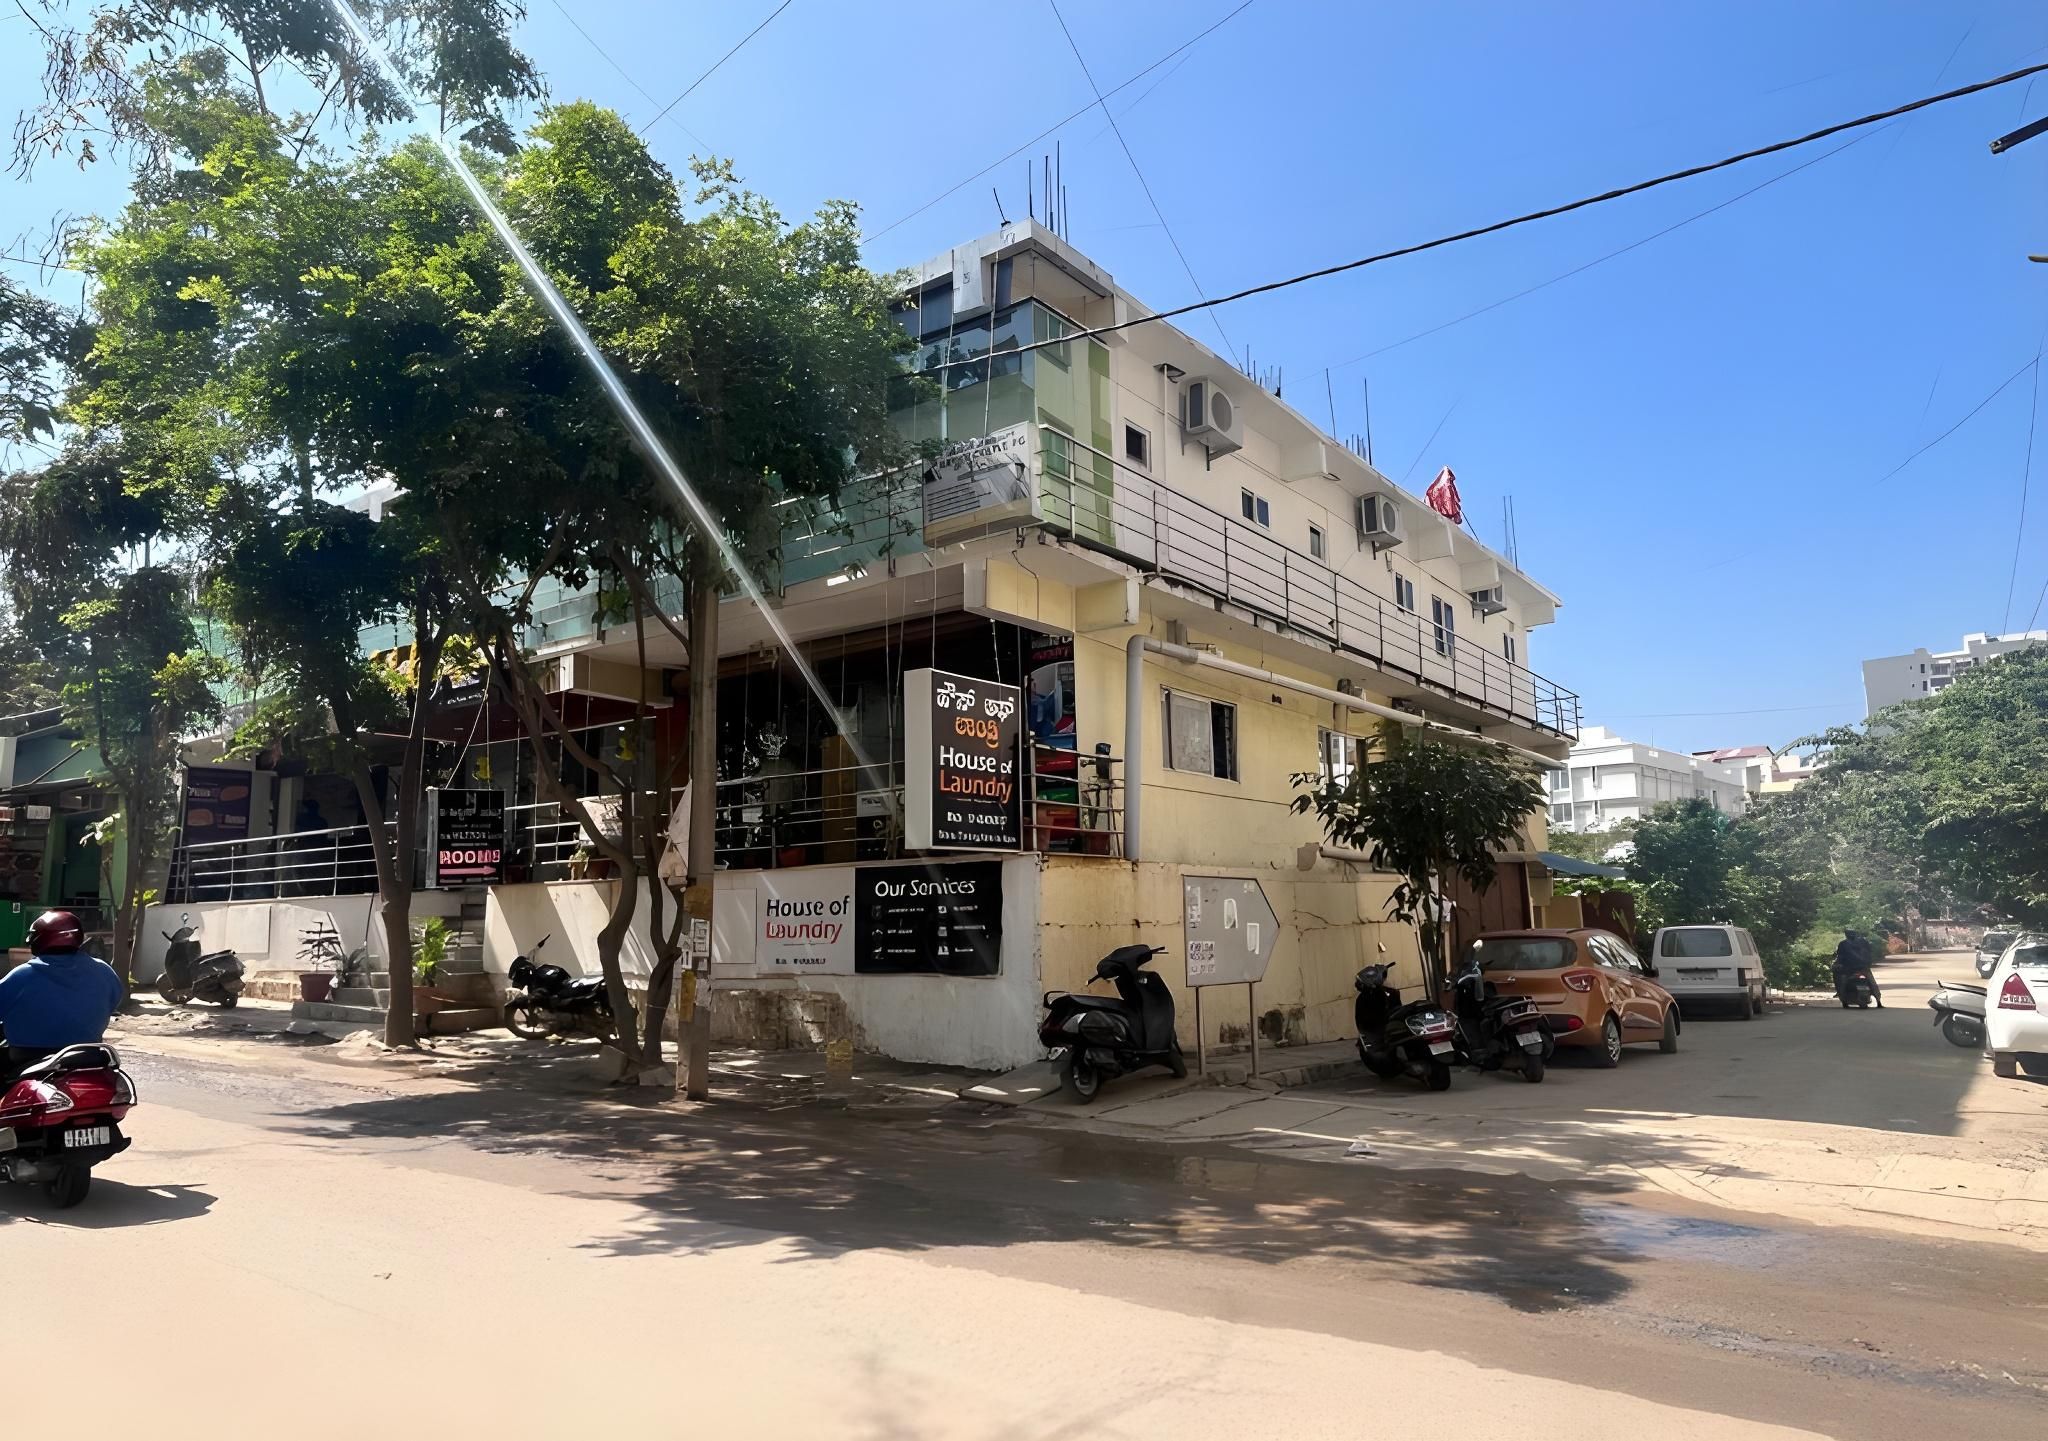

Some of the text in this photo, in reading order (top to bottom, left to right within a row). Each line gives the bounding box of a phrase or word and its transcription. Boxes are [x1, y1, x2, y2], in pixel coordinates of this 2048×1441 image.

[939, 745, 996, 773] House
[940, 769, 1013, 803] Laundry
[875, 880, 905, 897] Our
[766, 895, 850, 917] House of
[766, 920, 843, 944] Laundry
